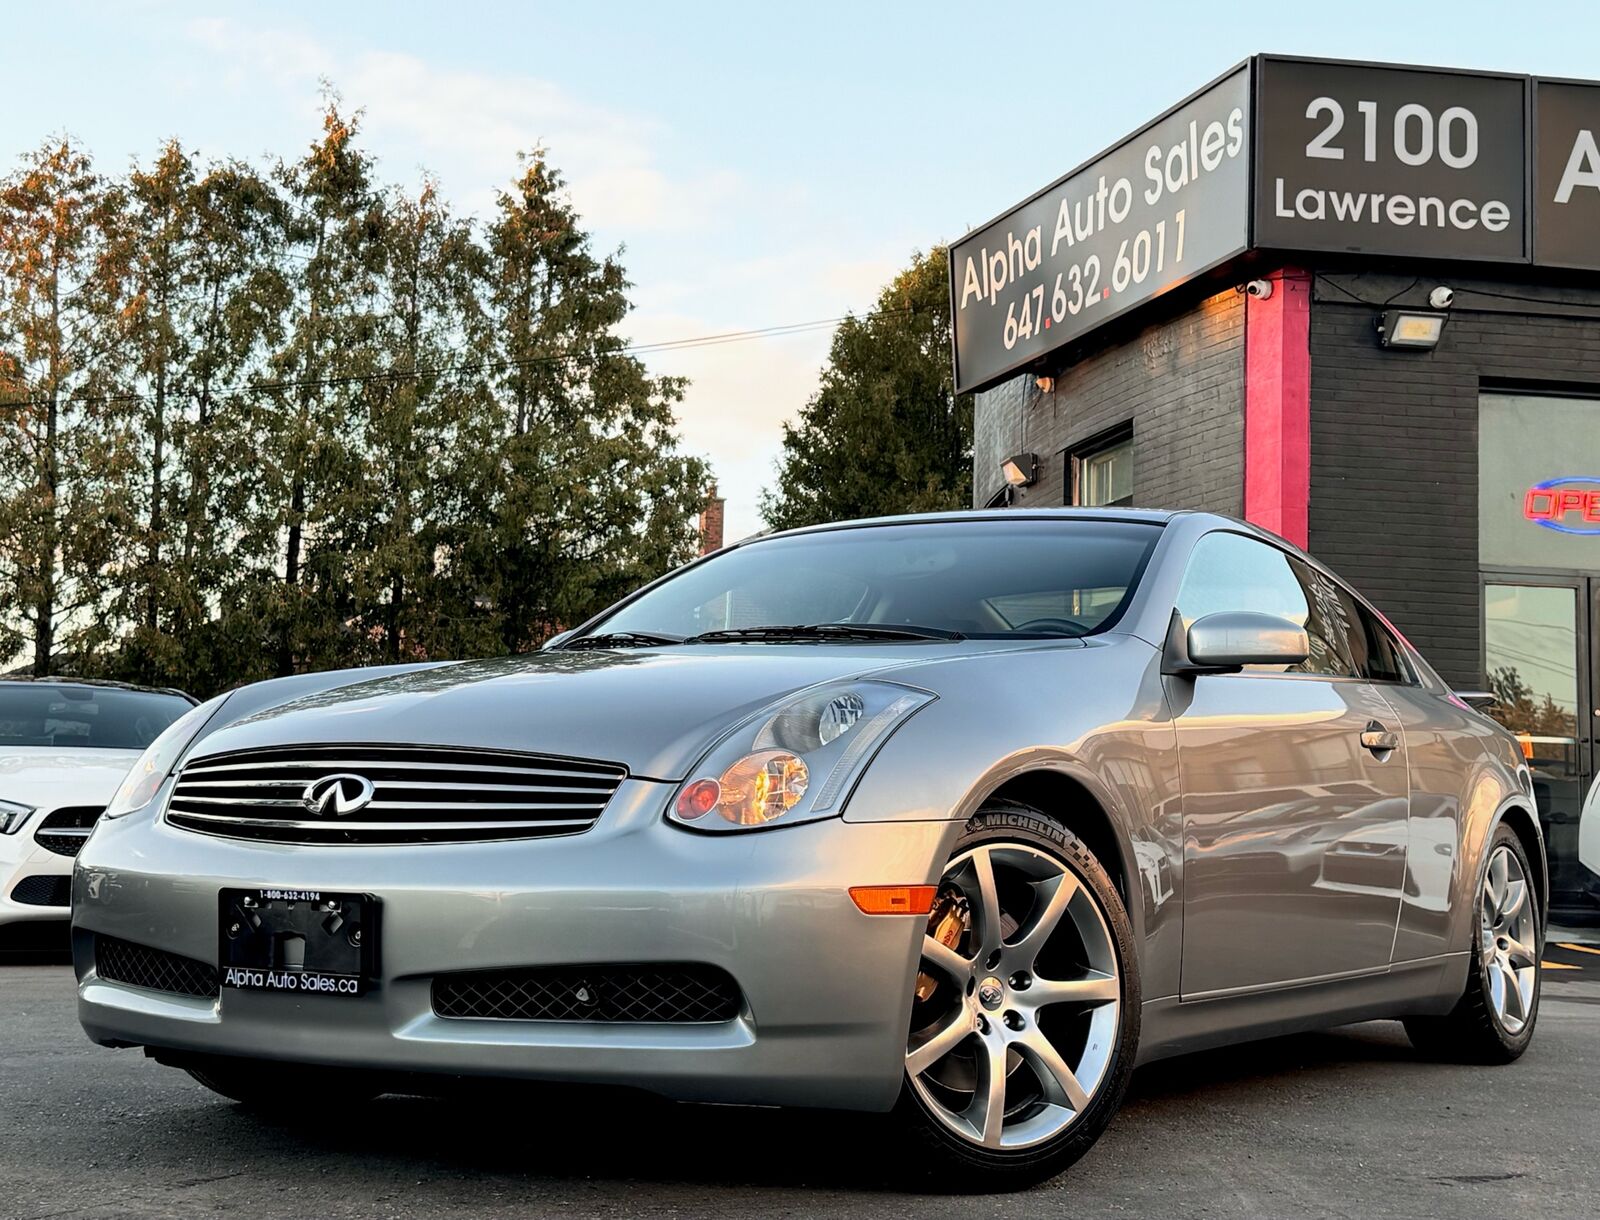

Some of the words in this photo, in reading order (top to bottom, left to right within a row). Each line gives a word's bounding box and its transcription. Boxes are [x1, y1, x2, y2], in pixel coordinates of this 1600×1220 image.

[1305, 97, 1478, 169] 2100
[960, 224, 1042, 310] Alpha
[1050, 175, 1133, 257] Auto
[1144, 107, 1244, 205] Sales
[1275, 178, 1511, 232] Lawrence
[1003, 208, 1186, 350] 647.632.6011
[985, 813, 1065, 843] MICHELIN
[259, 889, 321, 901] 1-800-632-4194
[225, 968, 264, 988] Alpha
[265, 971, 297, 989] Auto
[300, 973, 358, 993] Sales.ca
